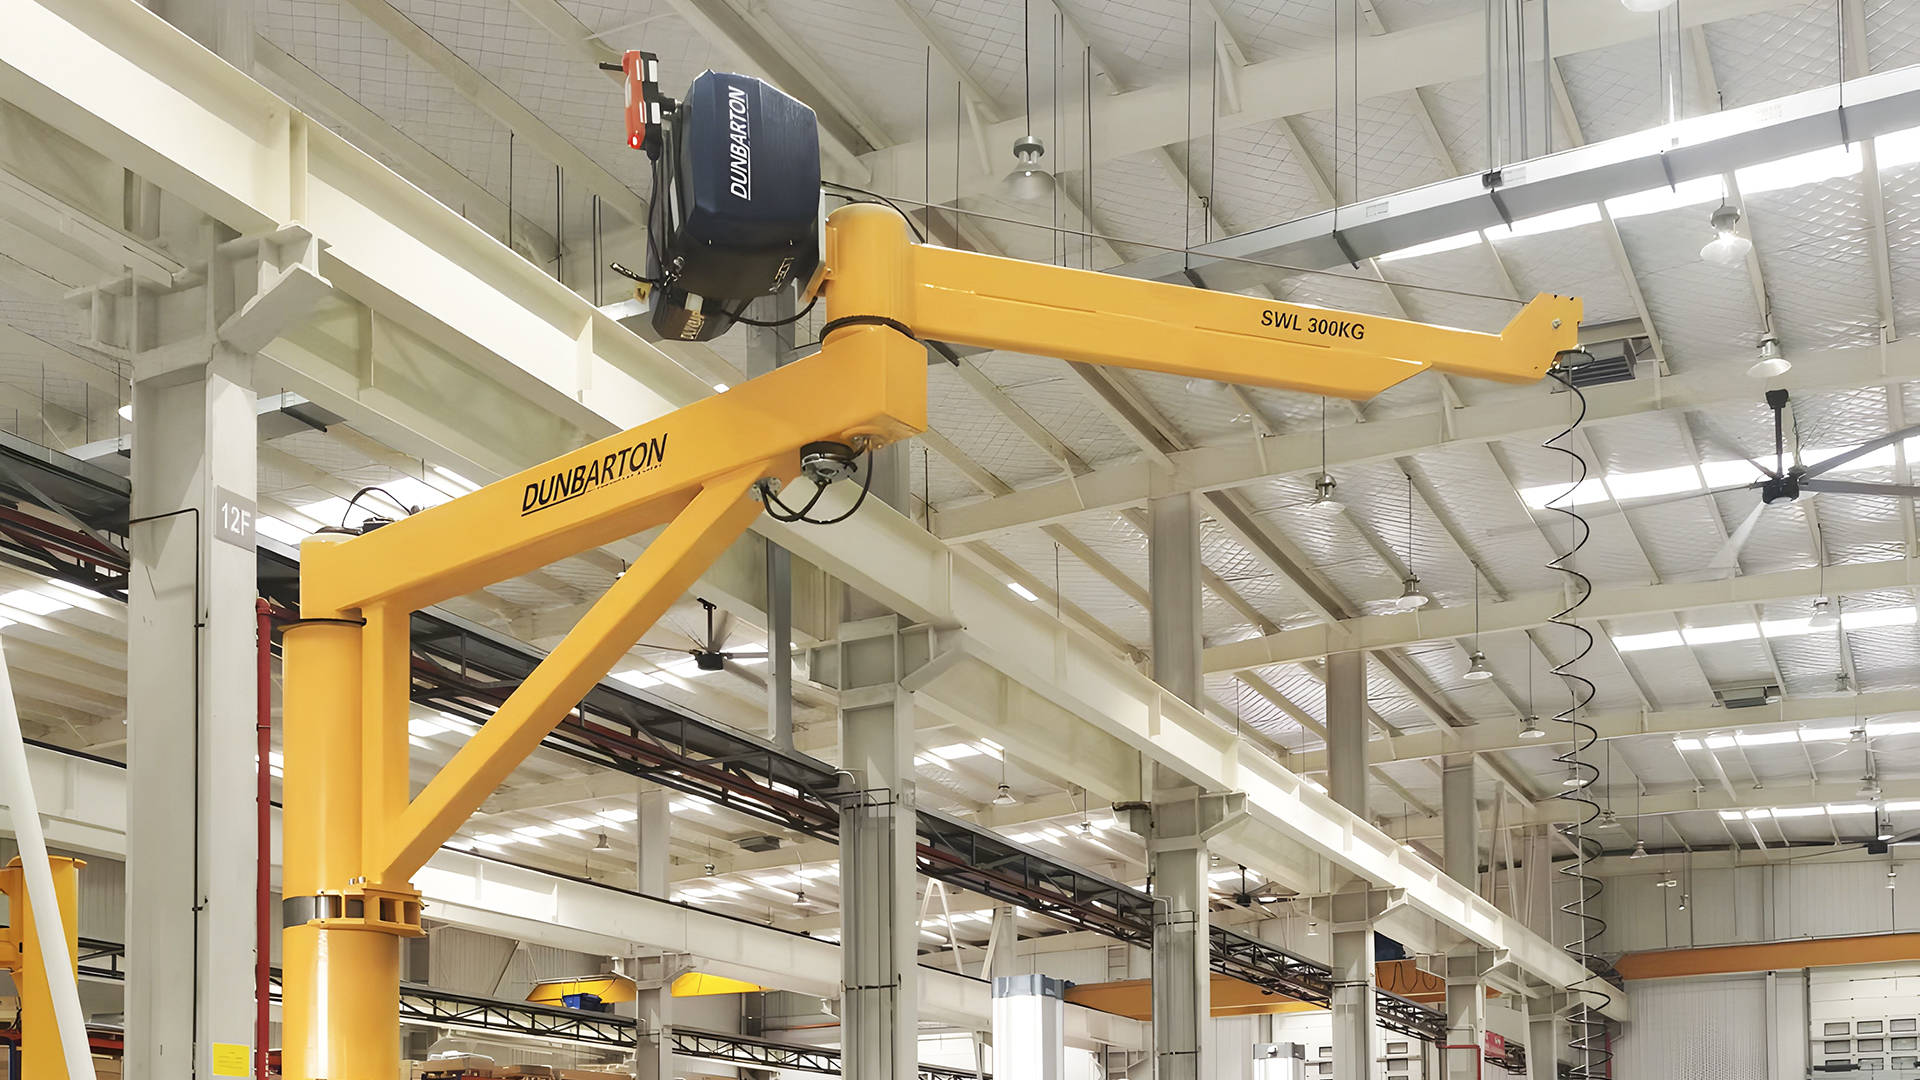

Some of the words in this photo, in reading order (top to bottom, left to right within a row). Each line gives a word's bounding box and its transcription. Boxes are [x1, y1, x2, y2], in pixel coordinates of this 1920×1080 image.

[728, 85, 749, 200] DUNBARTON
[1261, 310, 1302, 331] SWL
[1308, 317, 1365, 340] 300KG
[521, 432, 668, 514] DUNBARTON
[221, 501, 252, 536] 12F
